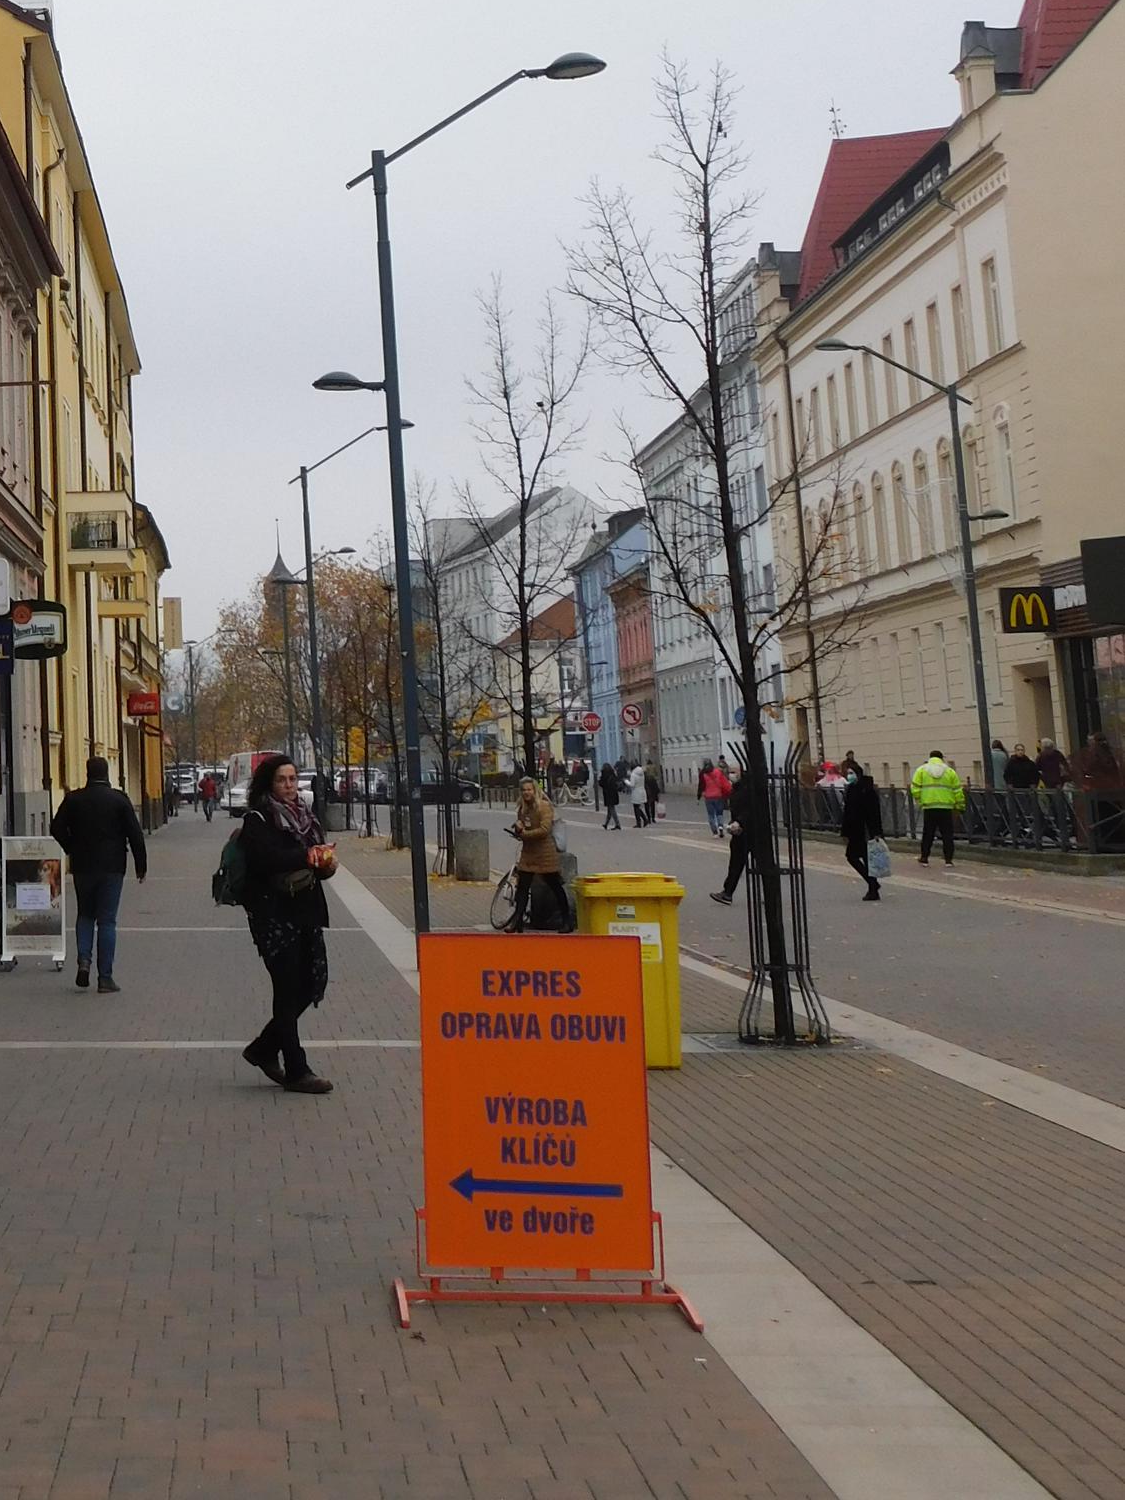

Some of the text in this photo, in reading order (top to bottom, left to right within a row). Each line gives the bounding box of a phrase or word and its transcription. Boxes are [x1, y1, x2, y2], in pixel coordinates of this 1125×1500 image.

[584, 717, 600, 726] STOP
[481, 969, 582, 998] EXPRES
[440, 1011, 627, 1044] OPRAVA OBUVI
[485, 1091, 588, 1127] VÝROBA
[500, 1132, 577, 1167] KLÍČŮ
[484, 1205, 595, 1235] ve dvoře
